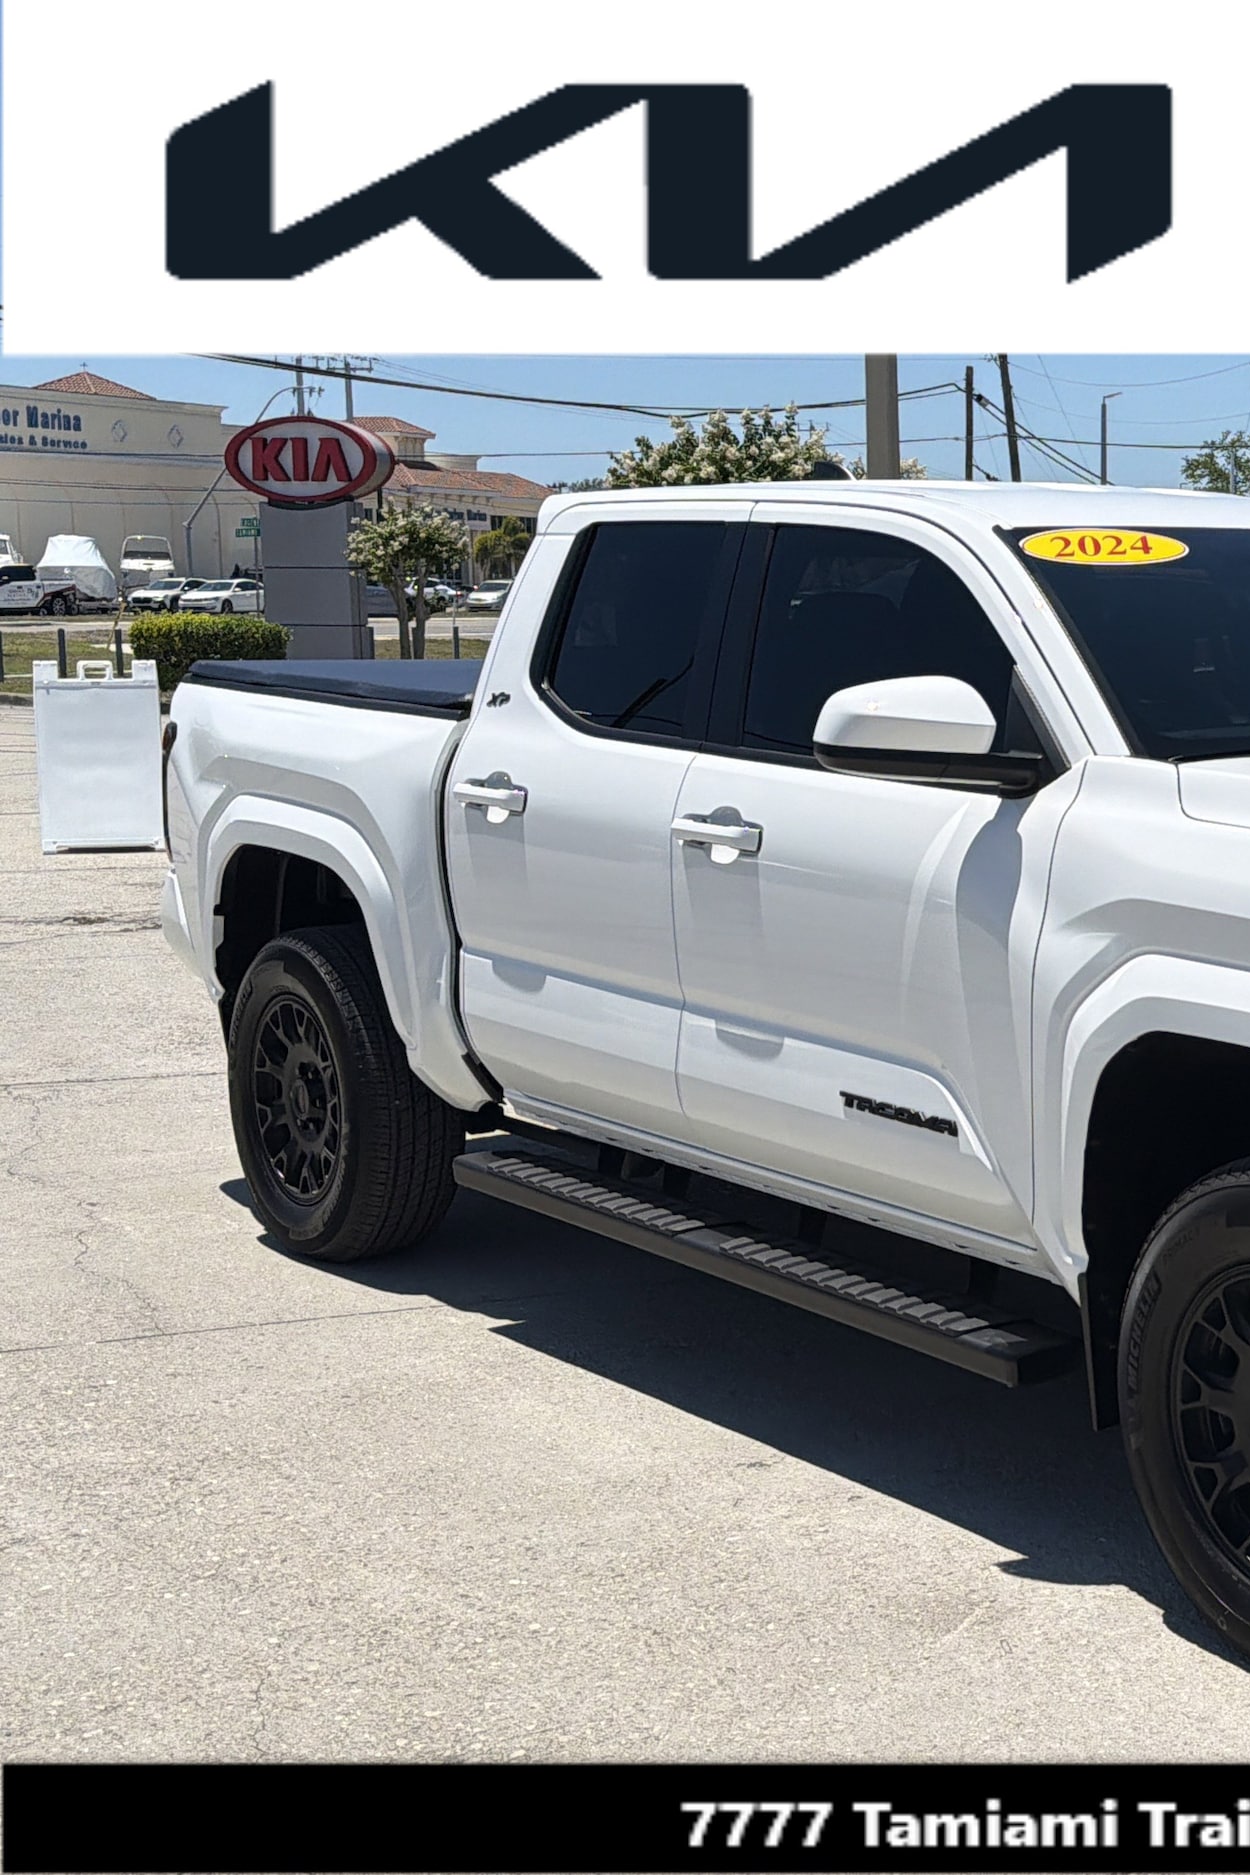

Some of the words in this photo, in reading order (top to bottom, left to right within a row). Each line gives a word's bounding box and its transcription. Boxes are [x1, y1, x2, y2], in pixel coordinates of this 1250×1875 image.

[26, 405, 82, 432] Marina
[250, 437, 352, 482] KIA
[1050, 535, 1153, 559] 2024
[839, 1090, 958, 1138] TACOMA
[1127, 1266, 1162, 1393] MICHELIN
